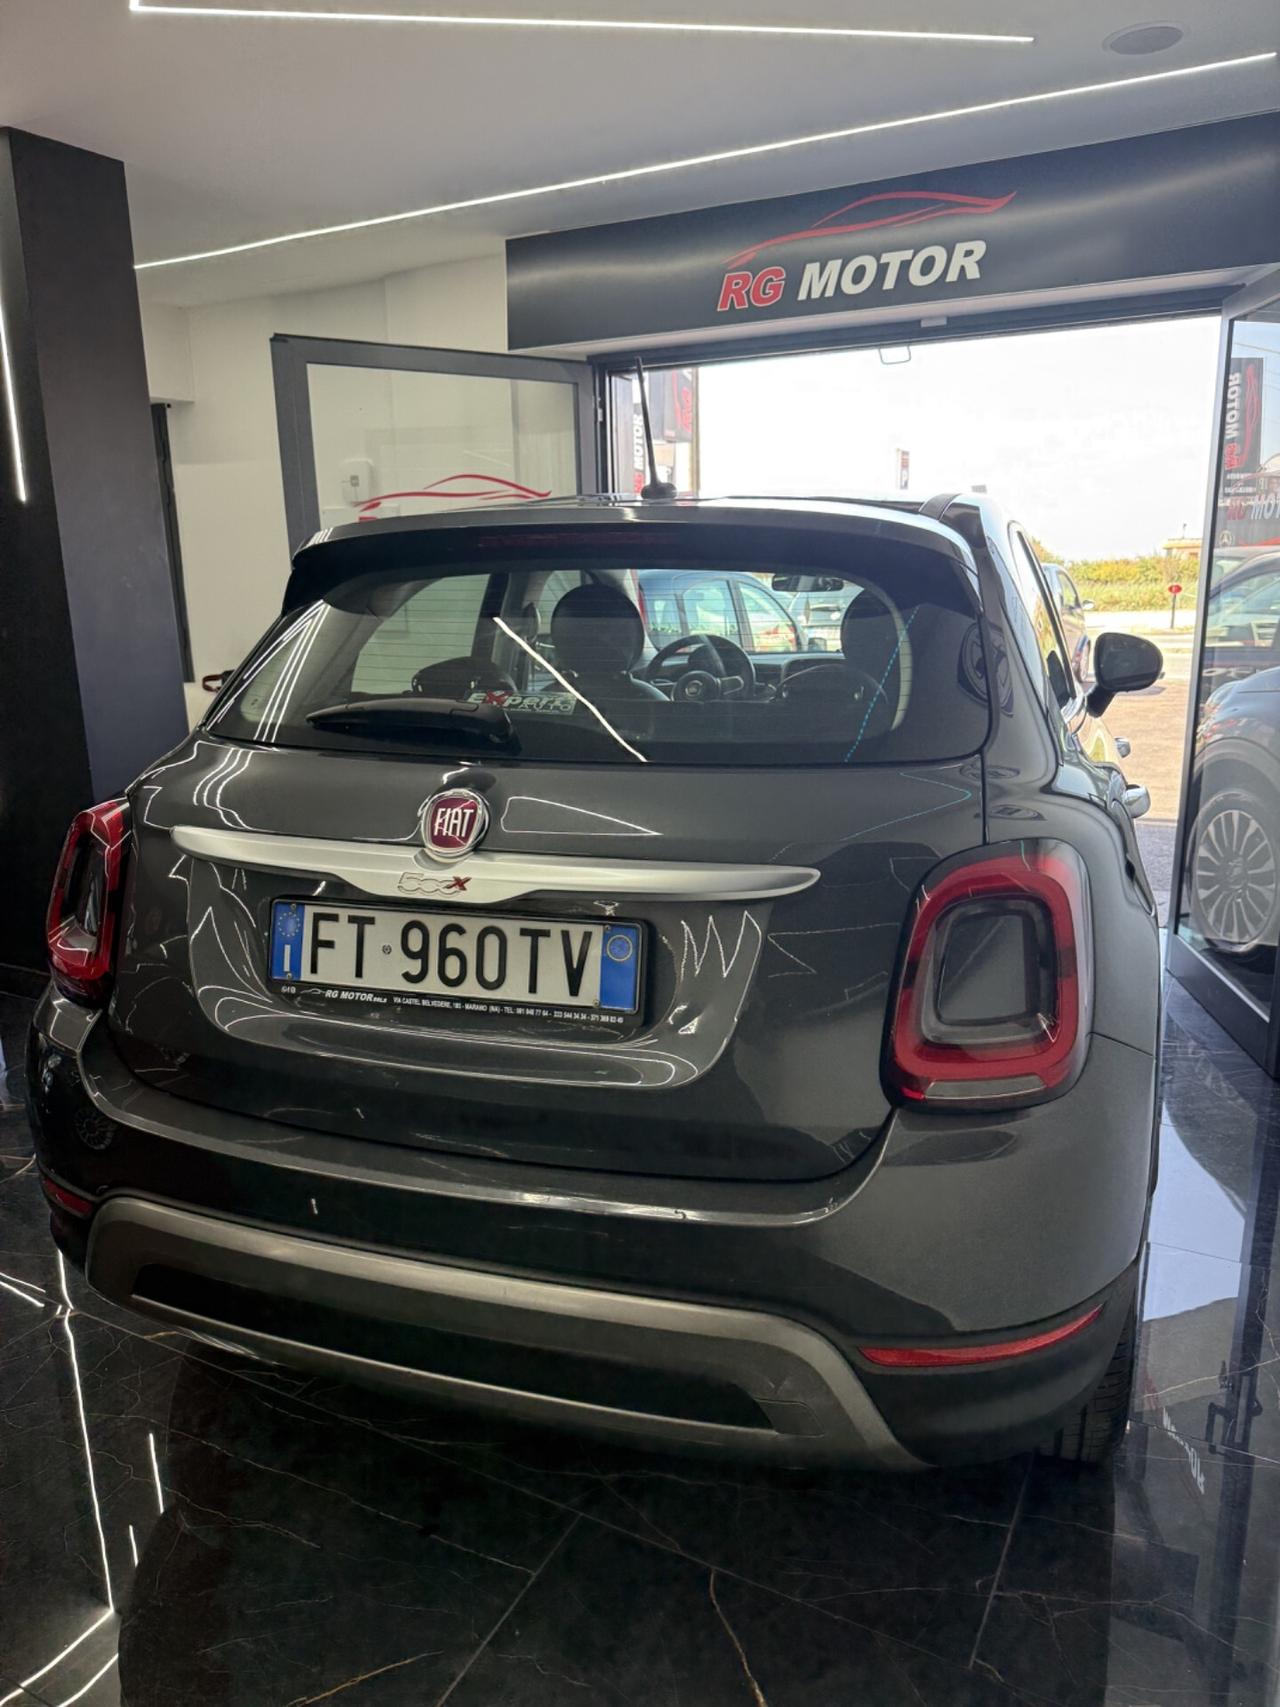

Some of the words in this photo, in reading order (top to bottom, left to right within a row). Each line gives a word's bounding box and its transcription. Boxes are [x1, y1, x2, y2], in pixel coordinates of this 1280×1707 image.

[717, 266, 785, 312] RG
[797, 239, 987, 301] MOTOR
[433, 807, 474, 838] FIAT
[309, 912, 376, 979] FT
[400, 919, 593, 997] 960TV
[325, 989, 338, 999] RG
[340, 990, 374, 1002] MOTOR
